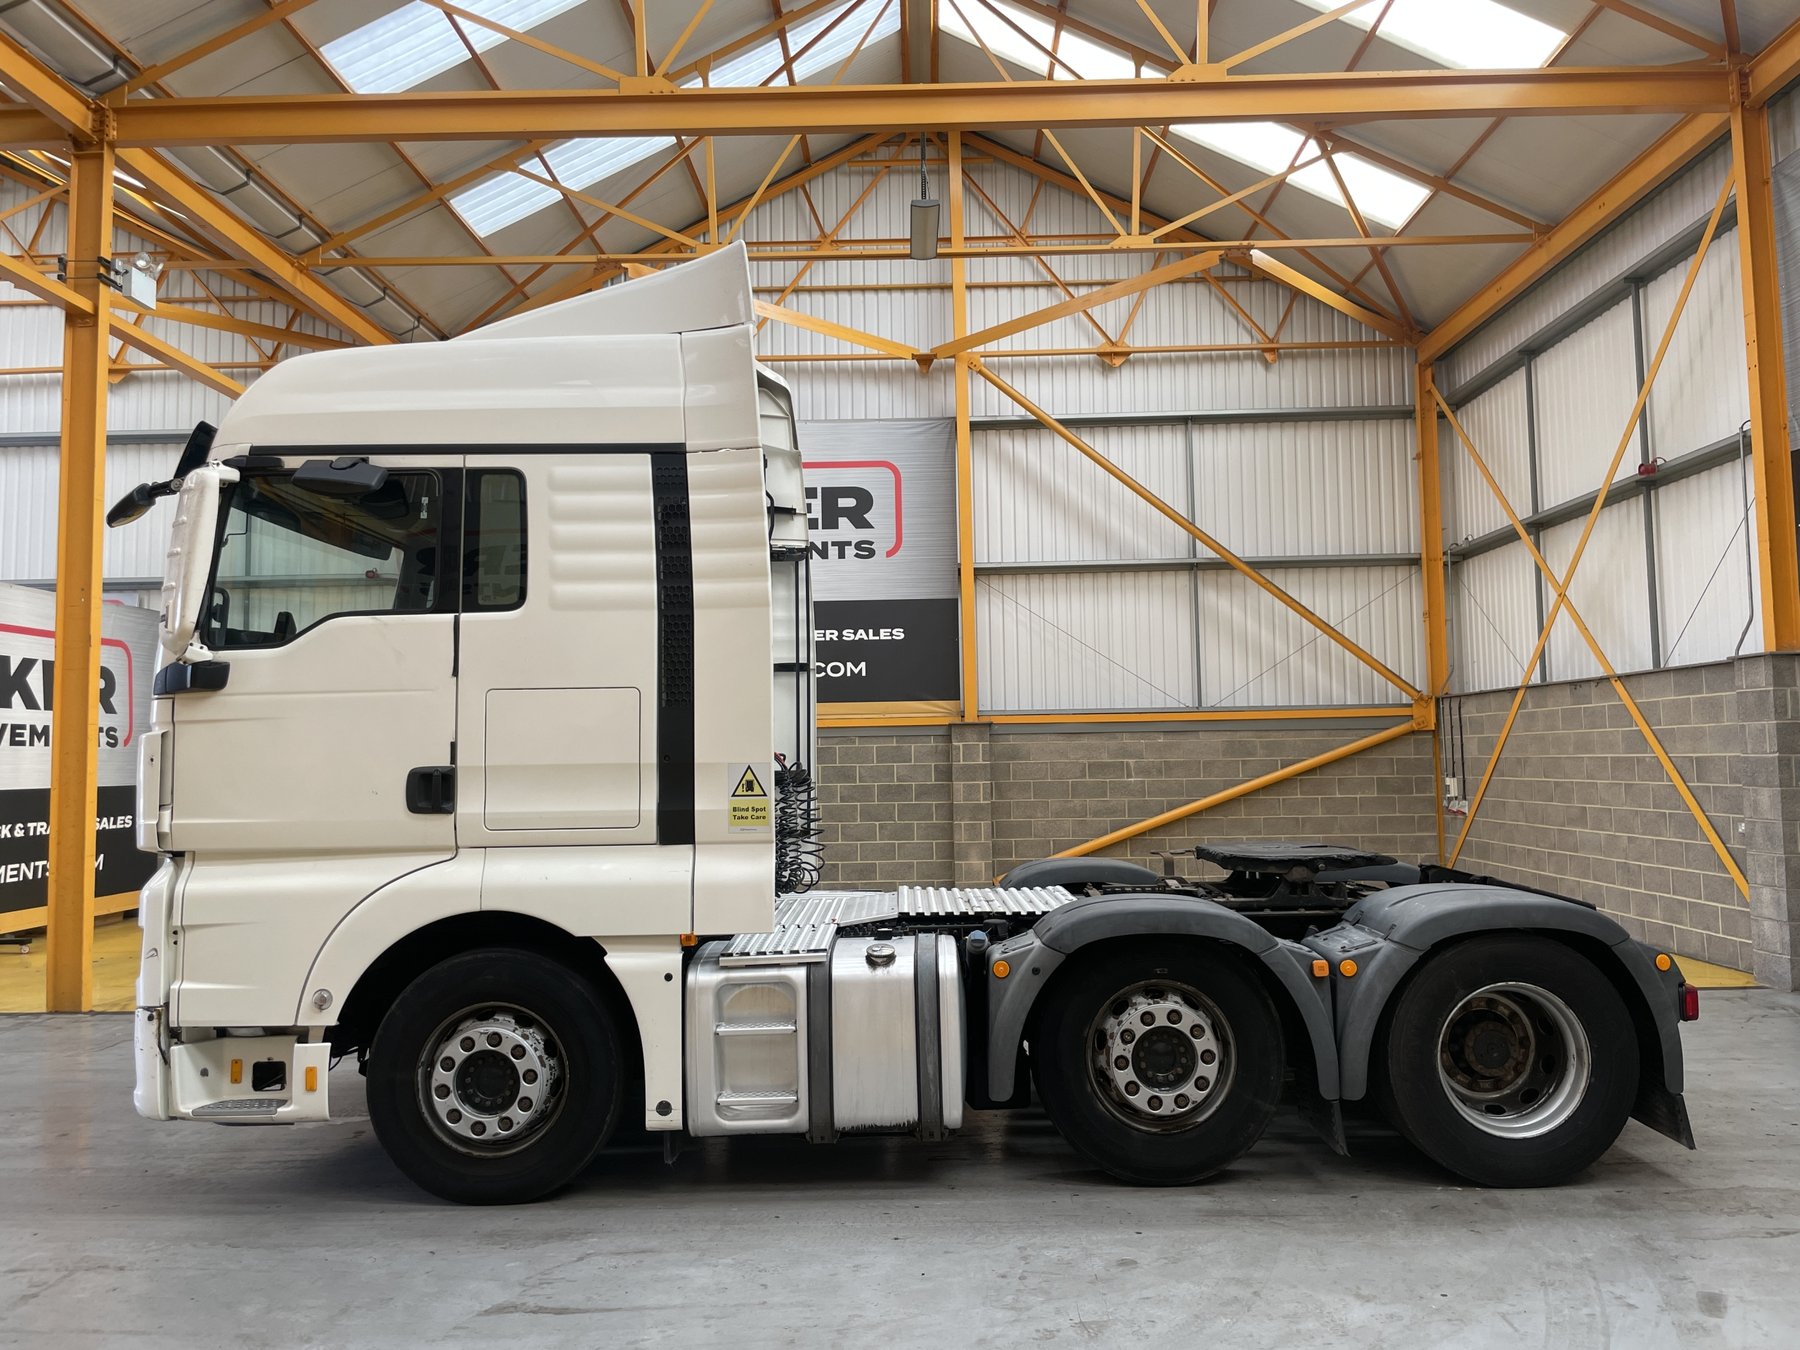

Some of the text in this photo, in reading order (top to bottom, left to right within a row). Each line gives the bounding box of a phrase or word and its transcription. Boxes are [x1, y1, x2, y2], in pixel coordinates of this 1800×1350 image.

[841, 628, 905, 641] SALES
[14, 823, 25, 837] &
[95, 815, 133, 830] SALES
